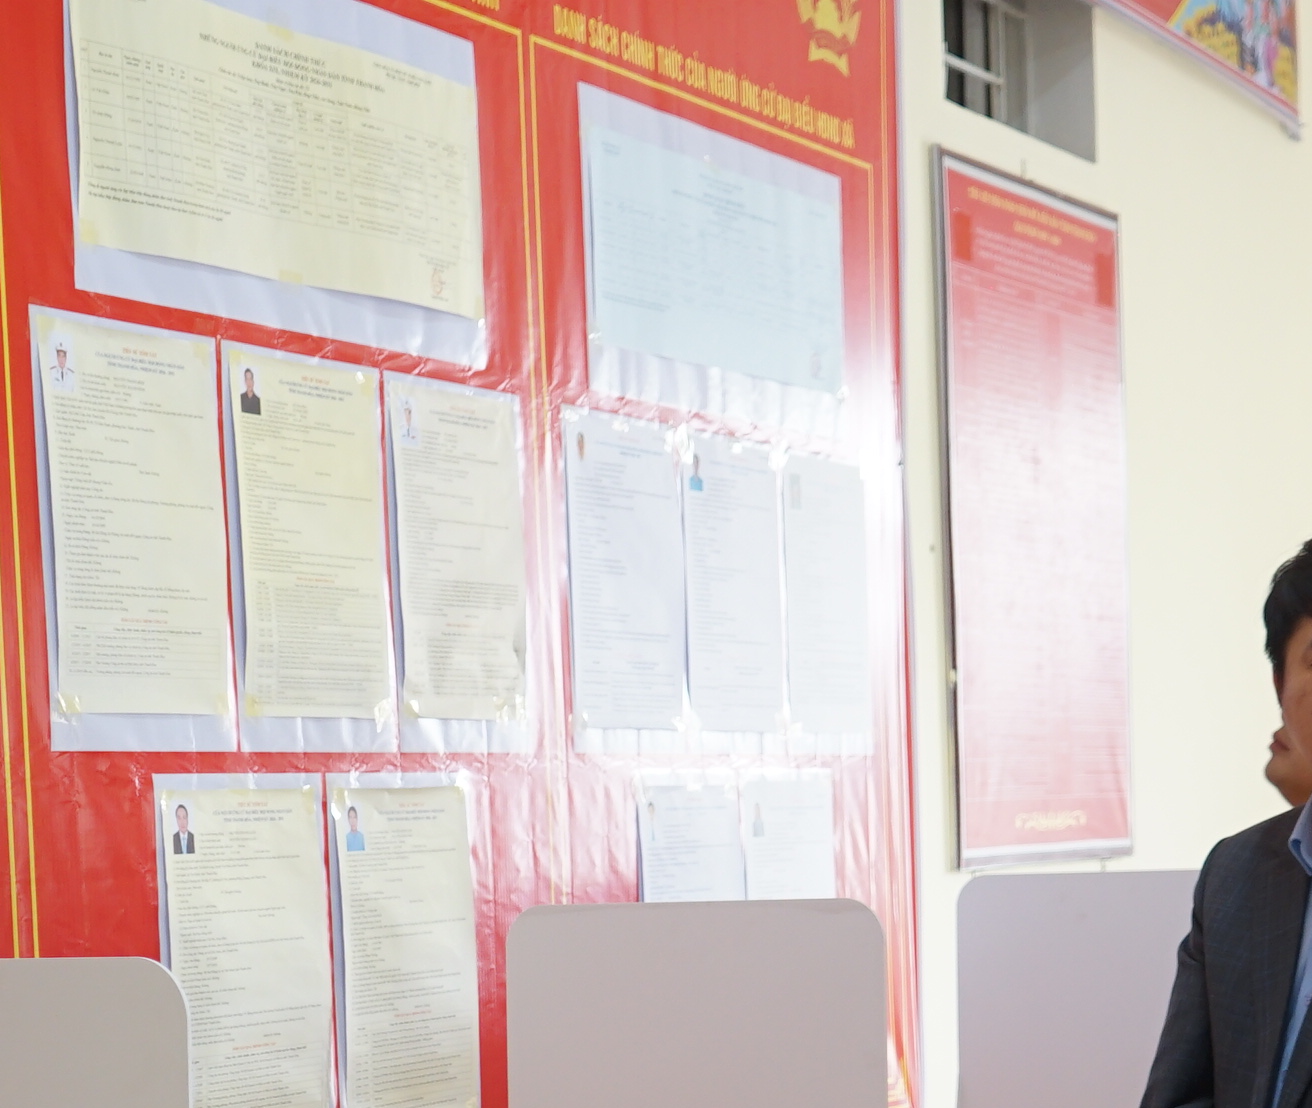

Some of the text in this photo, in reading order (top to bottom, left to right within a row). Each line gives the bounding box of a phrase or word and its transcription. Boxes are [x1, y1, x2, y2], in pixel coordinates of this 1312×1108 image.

[553, 3, 586, 45] DANH
[589, 14, 618, 57] SÁCH
[621, 30, 654, 71] CHÍNH
[657, 44, 684, 82] THỨC
[685, 50, 706, 91] CỦA
[708, 65, 739, 103] NGƯỜI
